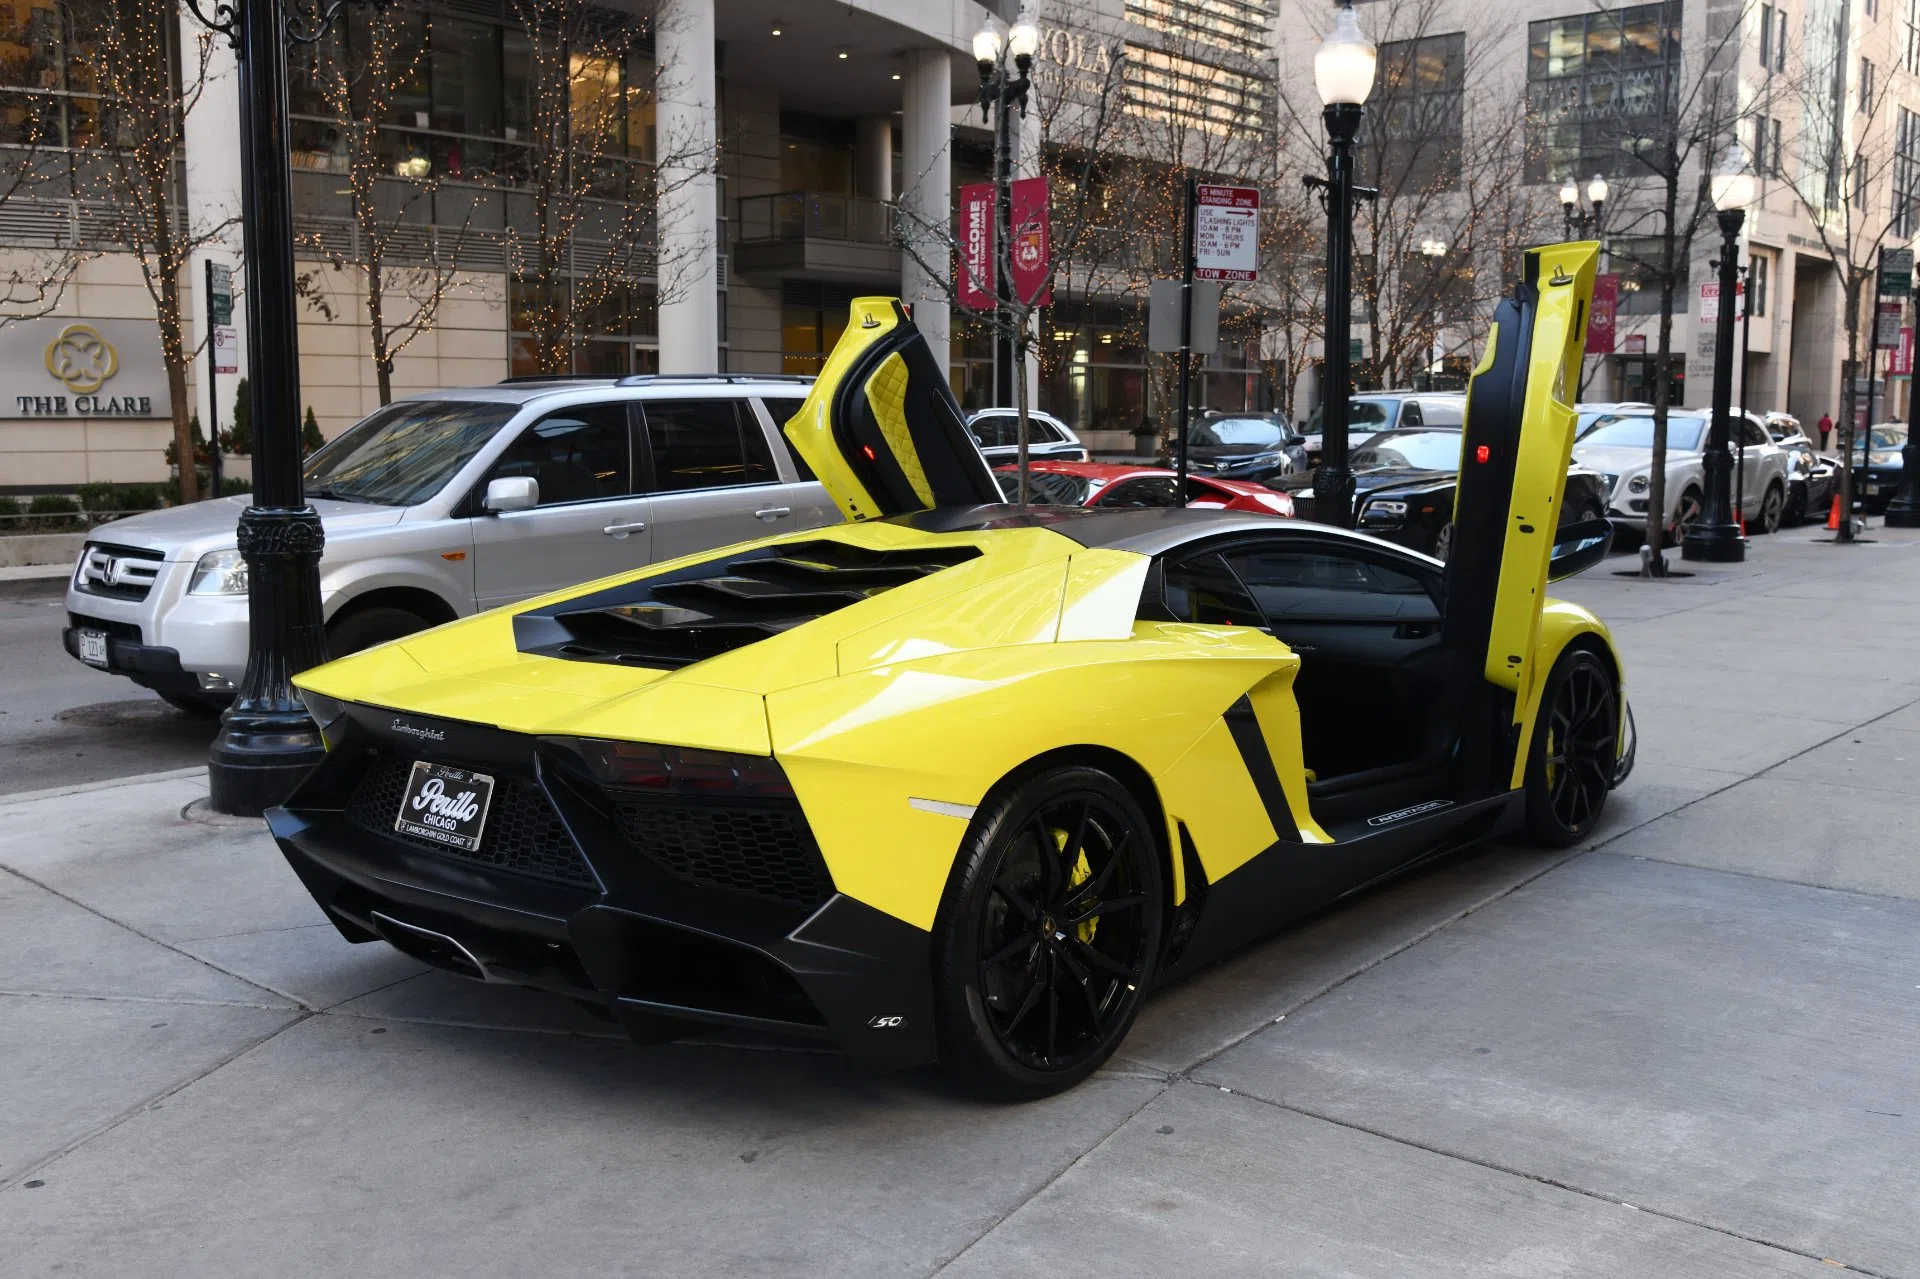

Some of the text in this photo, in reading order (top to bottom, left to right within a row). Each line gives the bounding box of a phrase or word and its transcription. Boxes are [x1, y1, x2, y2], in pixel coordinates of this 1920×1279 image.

[1040, 27, 1110, 75] YOLA
[1201, 187, 1234, 198] 15 MINUTE
[1201, 196, 1253, 207] STANDING ZONE
[1200, 208, 1214, 217] USE
[1200, 216, 1255, 227] FLASHING LIGHTS
[1200, 232, 1215, 240] MON
[1222, 233, 1244, 242] THURS
[968, 200, 980, 294] WELCOME
[1200, 248, 1211, 257] FRI
[1217, 249, 1231, 258] SUN
[1200, 269, 1251, 281] TOW ZONE
[16, 396, 152, 414] THE CLARE
[391, 718, 445, 741] Lamborghini
[437, 767, 465, 780] Perillo
[412, 778, 479, 823] Perillo
[423, 813, 457, 831] CHICAGO
[406, 824, 466, 846] LAMBORGHINI GOLD COAST
